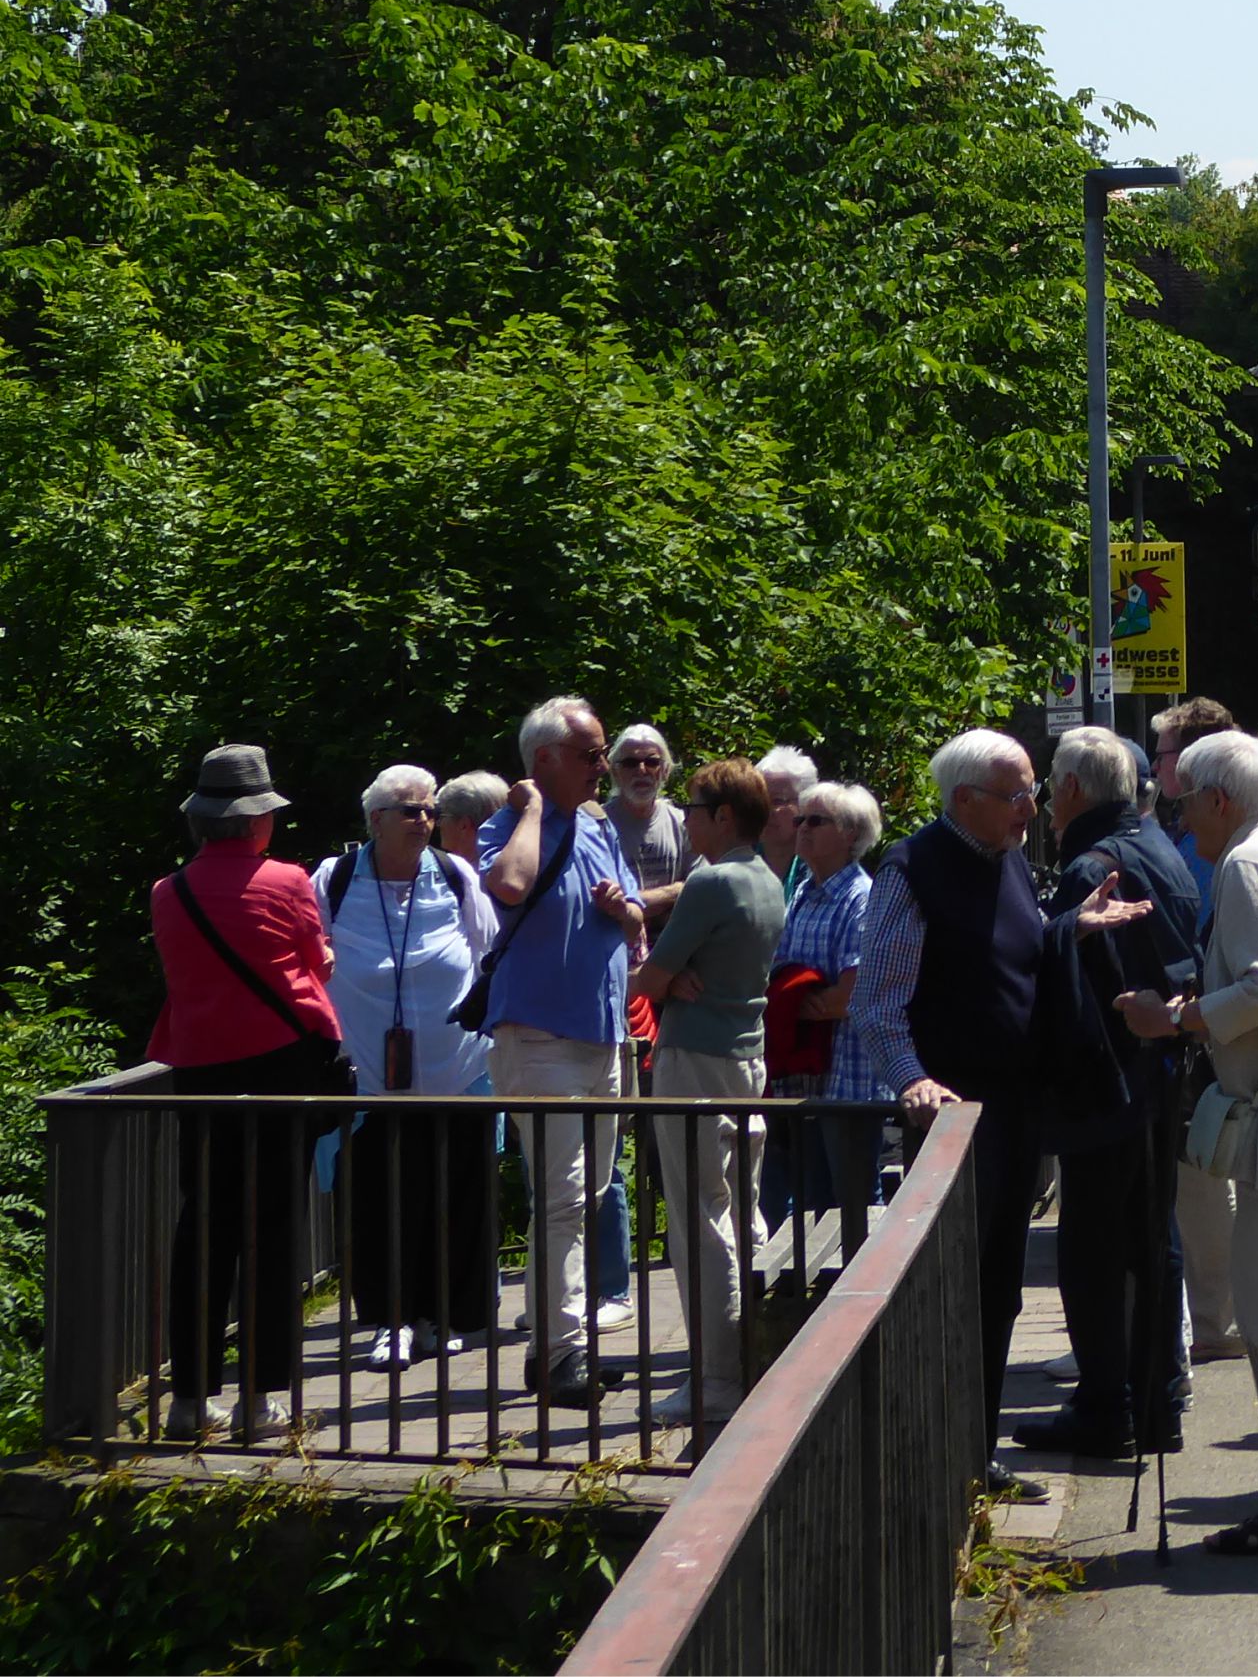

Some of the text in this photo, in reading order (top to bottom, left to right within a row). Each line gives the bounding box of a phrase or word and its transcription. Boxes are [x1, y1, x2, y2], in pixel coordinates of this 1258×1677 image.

[1120, 549, 1136, 562] 11.
[1142, 548, 1175, 562] Juni
[1112, 648, 1180, 662] dwest
[1116, 664, 1180, 678] esse
